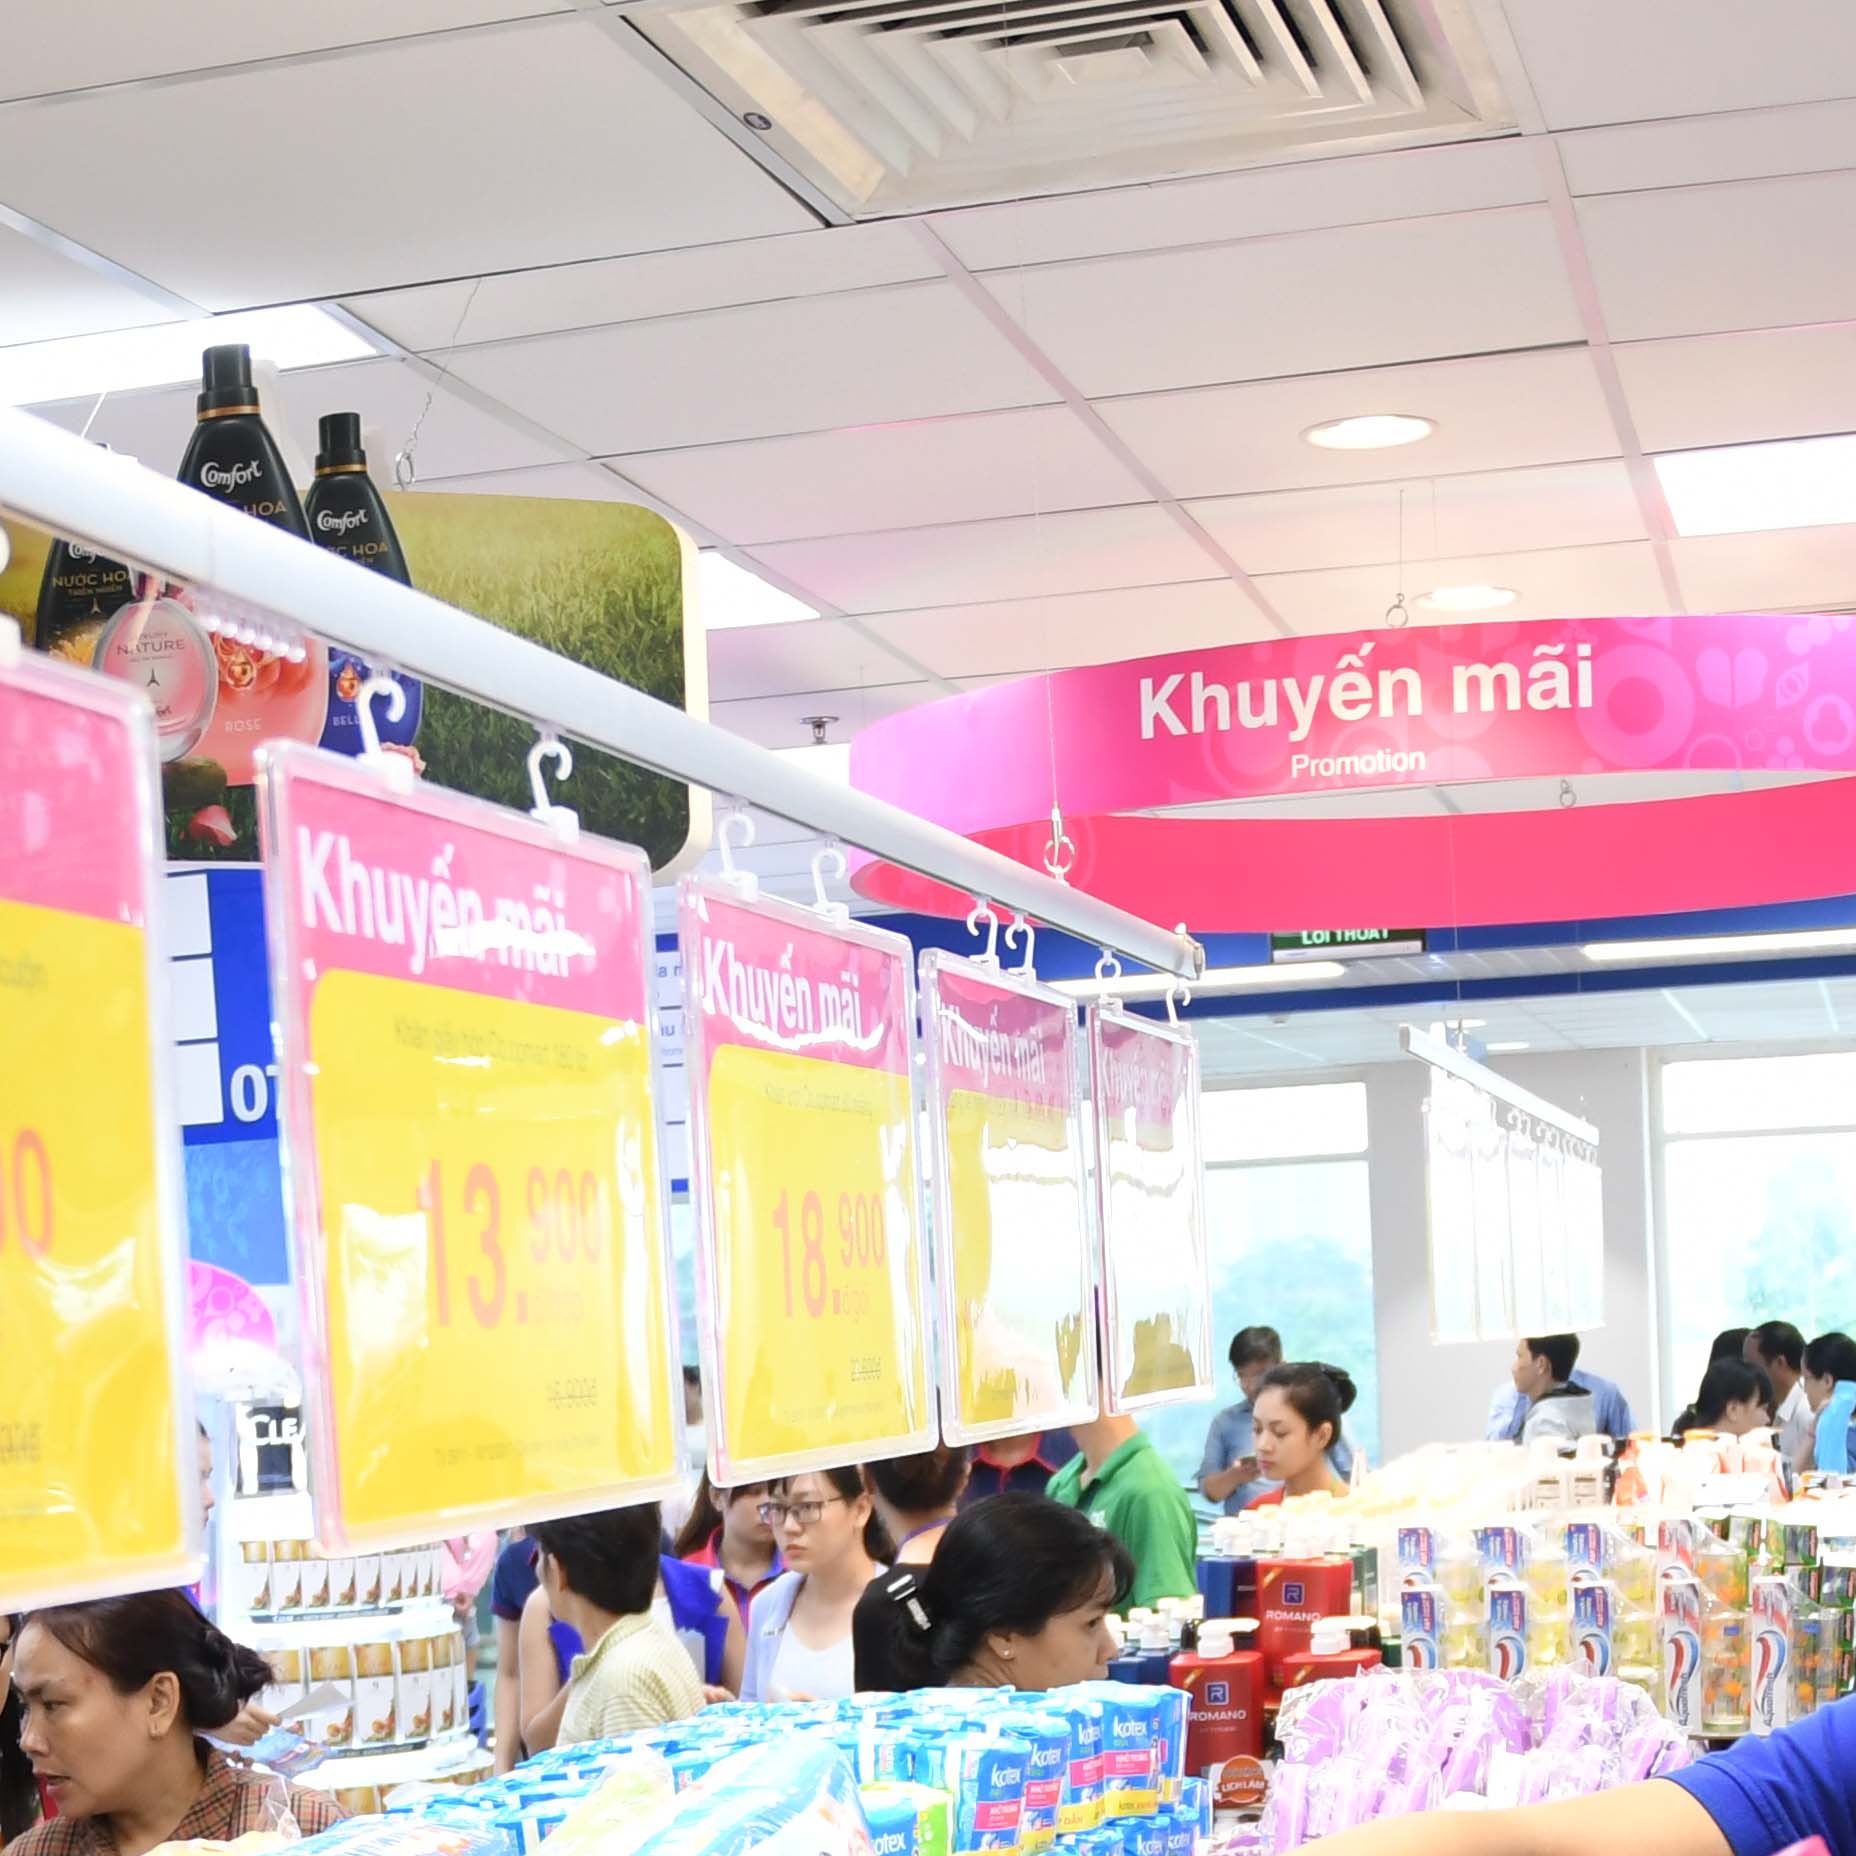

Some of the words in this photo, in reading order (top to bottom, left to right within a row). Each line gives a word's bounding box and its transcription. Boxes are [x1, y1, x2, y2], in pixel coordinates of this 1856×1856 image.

[200, 459, 263, 494] Comfort
[317, 508, 369, 537] Comfort
[1140, 642, 1424, 742] Khuyến
[1451, 642, 1594, 715] mãi
[1291, 747, 1426, 780] Promotion
[297, 826, 486, 975] Khuyến
[703, 936, 814, 1033] Khuyến
[818, 969, 863, 1041] mãi
[1266, 1610, 1322, 1623] ROMANO
[1113, 1715, 1148, 1739] kotex
[1189, 1708, 1247, 1722] ROMANO
[1031, 1742, 1062, 1768] kotex
[991, 1763, 1022, 1788] kotex
